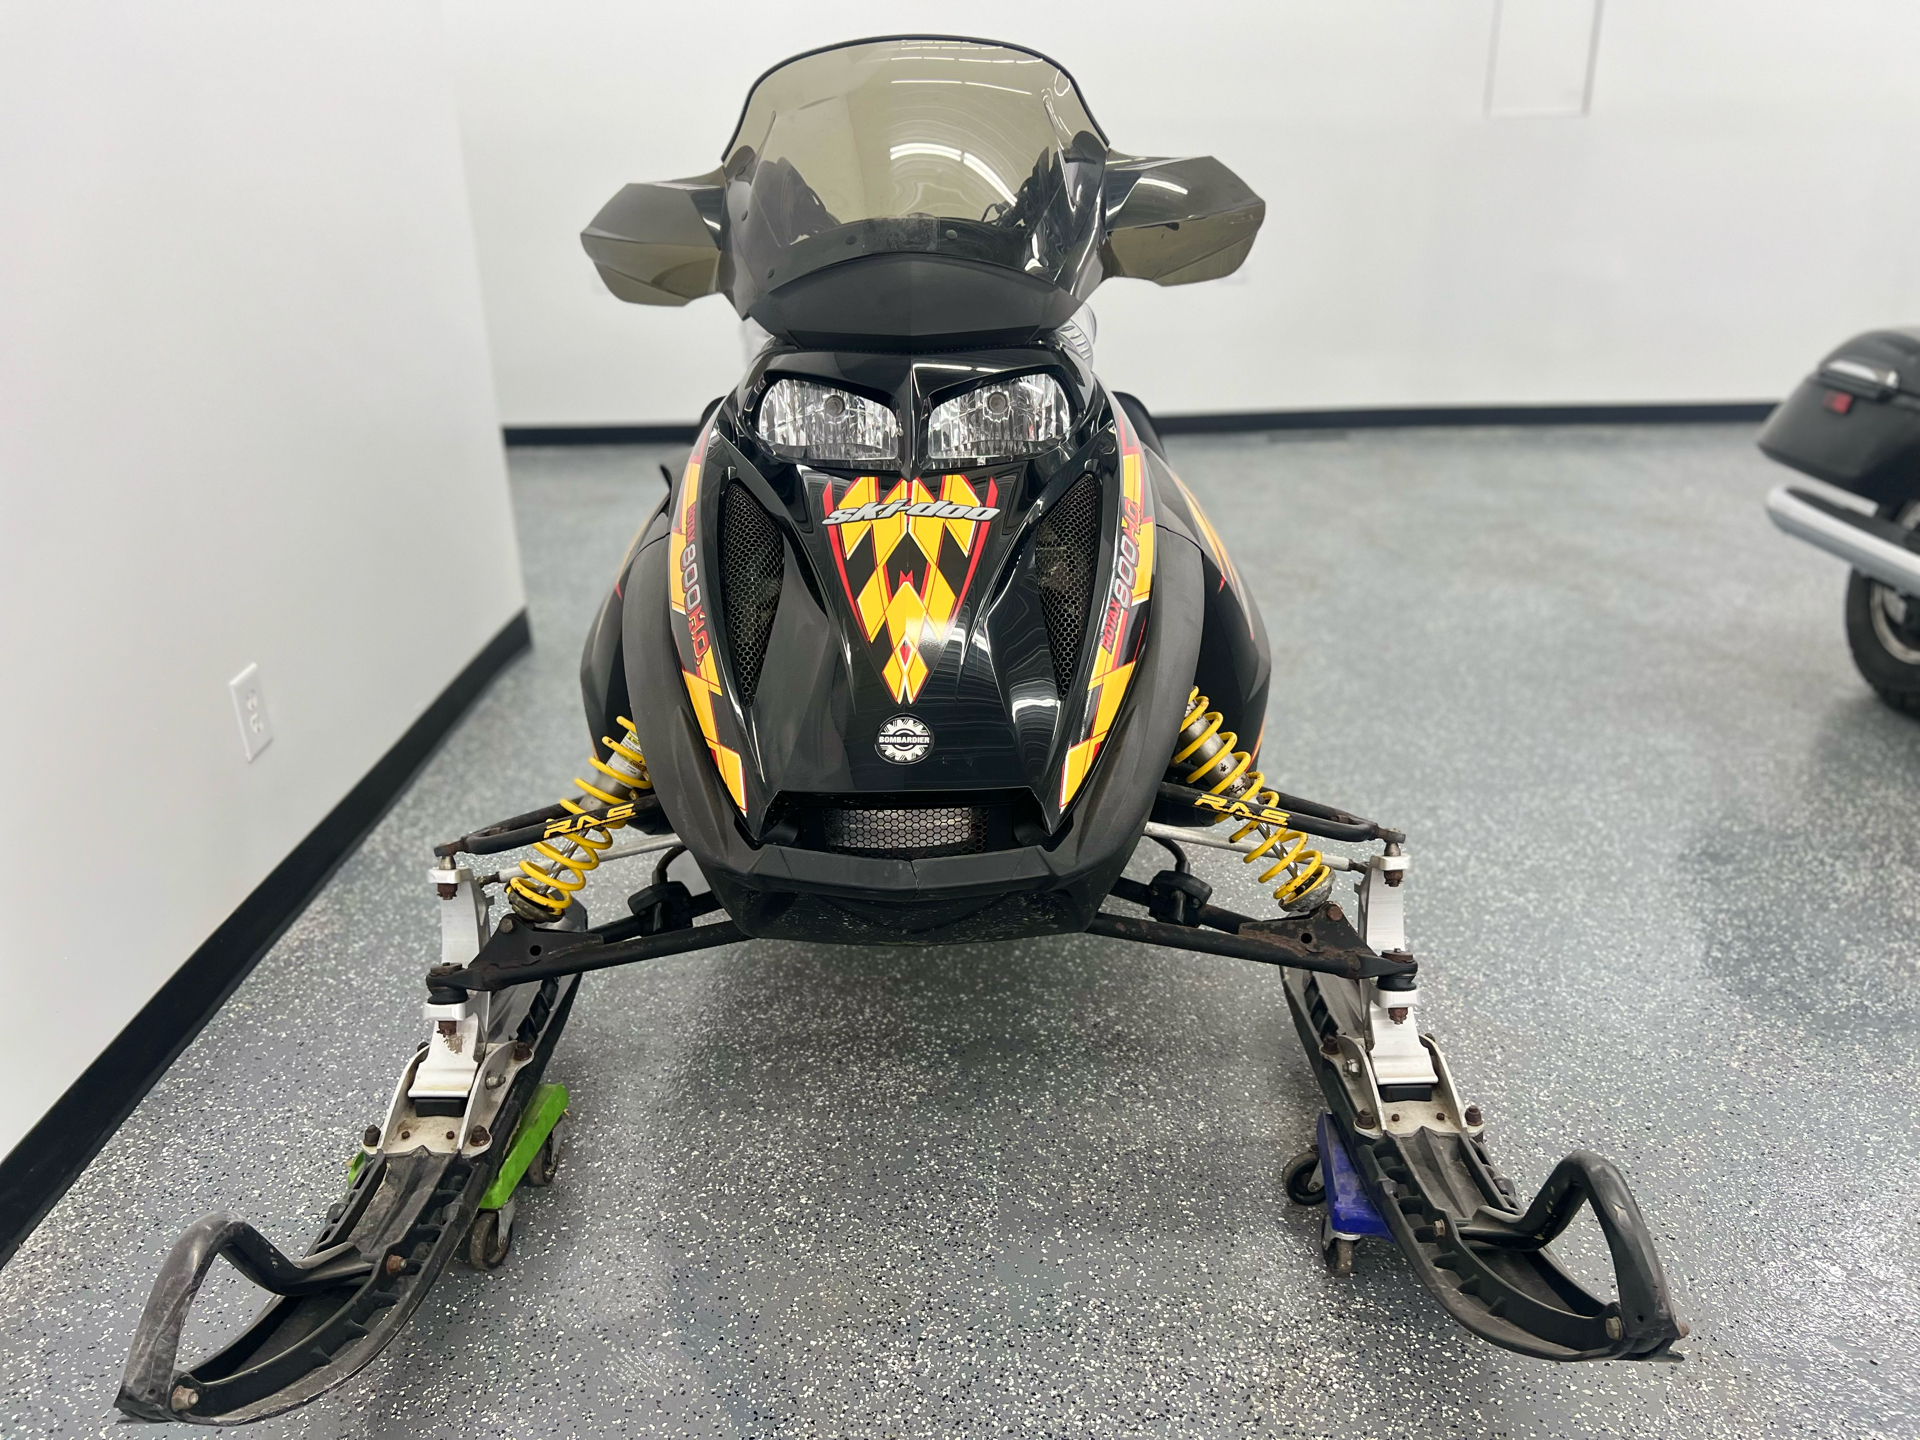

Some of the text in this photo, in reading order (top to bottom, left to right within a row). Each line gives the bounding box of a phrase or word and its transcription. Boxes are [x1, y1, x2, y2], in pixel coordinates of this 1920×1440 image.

[821, 498, 1001, 526] ski-doo
[1102, 598, 1122, 655] ROTAX
[878, 736, 931, 744] BOMBARDIER
